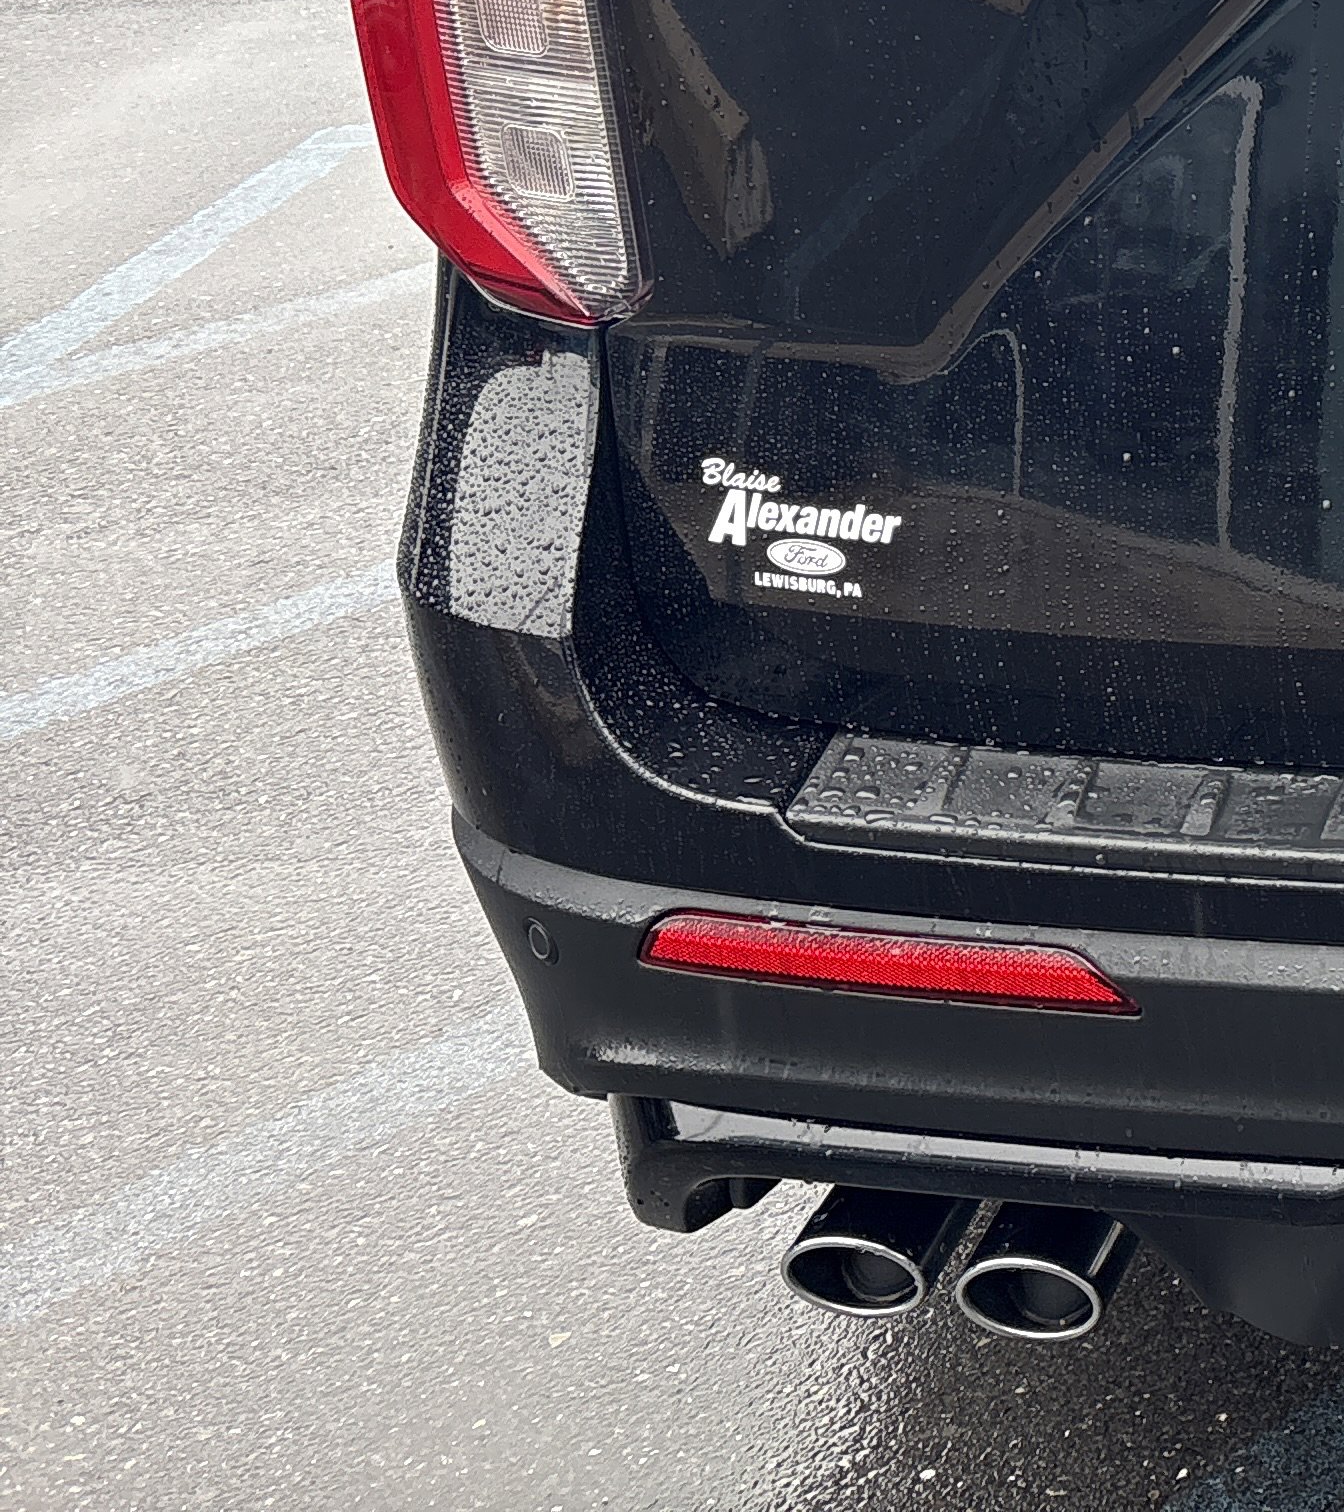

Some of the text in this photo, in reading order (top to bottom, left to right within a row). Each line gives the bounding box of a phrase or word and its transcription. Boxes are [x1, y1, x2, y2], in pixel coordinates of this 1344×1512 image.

[701, 457, 782, 493] Blaise
[707, 488, 903, 547] Alexander
[783, 543, 829, 569] Ford
[754, 571, 863, 599] LEWISBURG, PA
